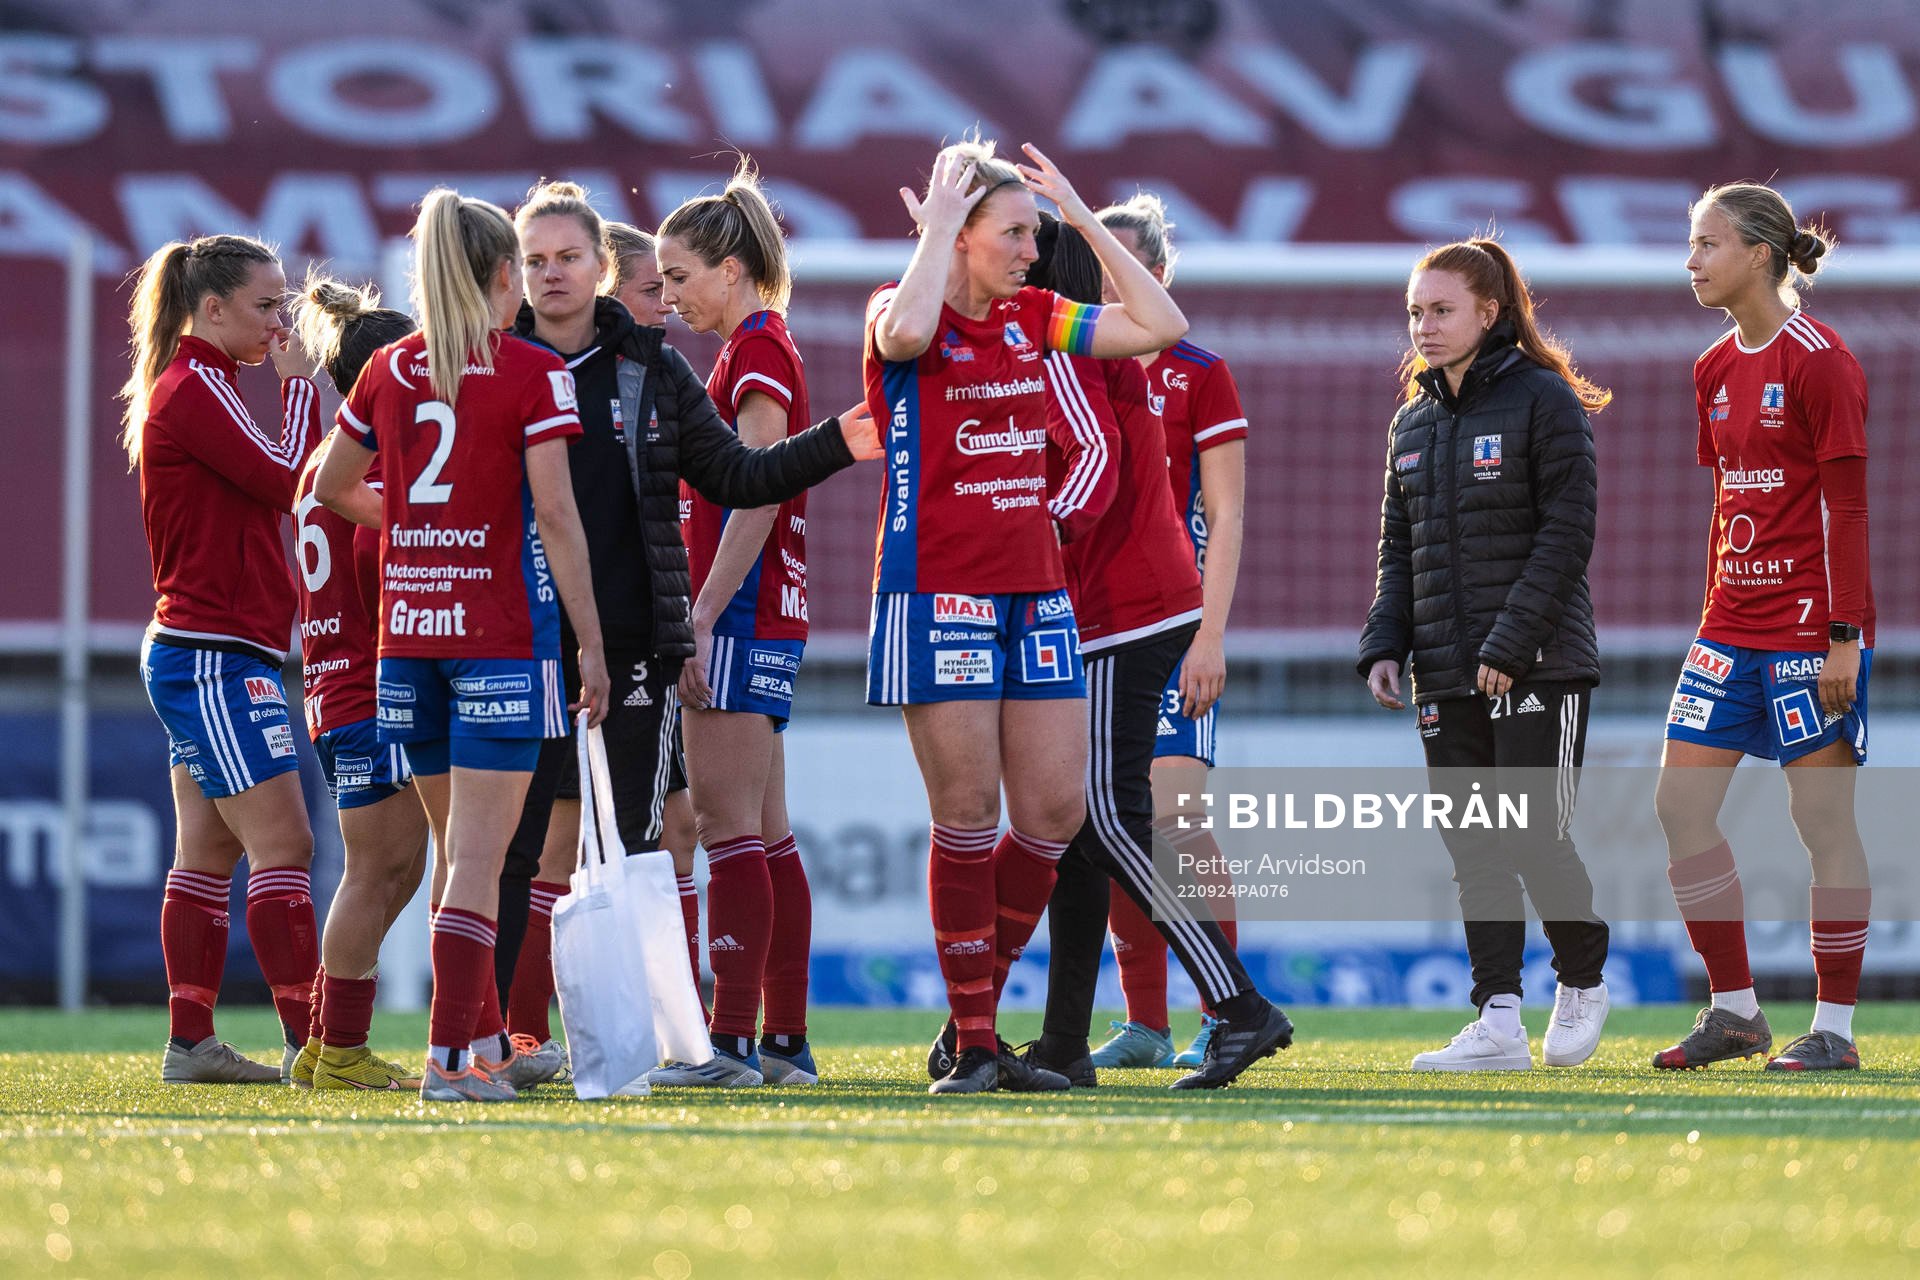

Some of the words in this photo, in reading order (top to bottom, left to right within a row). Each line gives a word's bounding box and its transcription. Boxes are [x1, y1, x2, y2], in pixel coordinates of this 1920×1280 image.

[1062, 42, 1274, 150] AV
[409, 401, 456, 504] 2
[992, 494, 1040, 511] Sparbank
[391, 523, 486, 548] furninova
[386, 563, 493, 580] Motorcentrum
[436, 582, 452, 592] AB
[1741, 577, 1783, 586] NYKÖPING
[936, 597, 994, 619] MAXI
[1797, 598, 1813, 624] 7
[390, 600, 467, 636] Grant
[943, 630, 969, 641] GÖSTA
[944, 659, 987, 667] HYNGARPS
[487, 681, 526, 691] GRUPPEN
[1693, 681, 1727, 698] AHLQUIST
[463, 700, 520, 717] PEAB
[1490, 692, 1511, 719] 21
[1517, 705, 1545, 713] adidas
[945, 943, 989, 955] adidas
